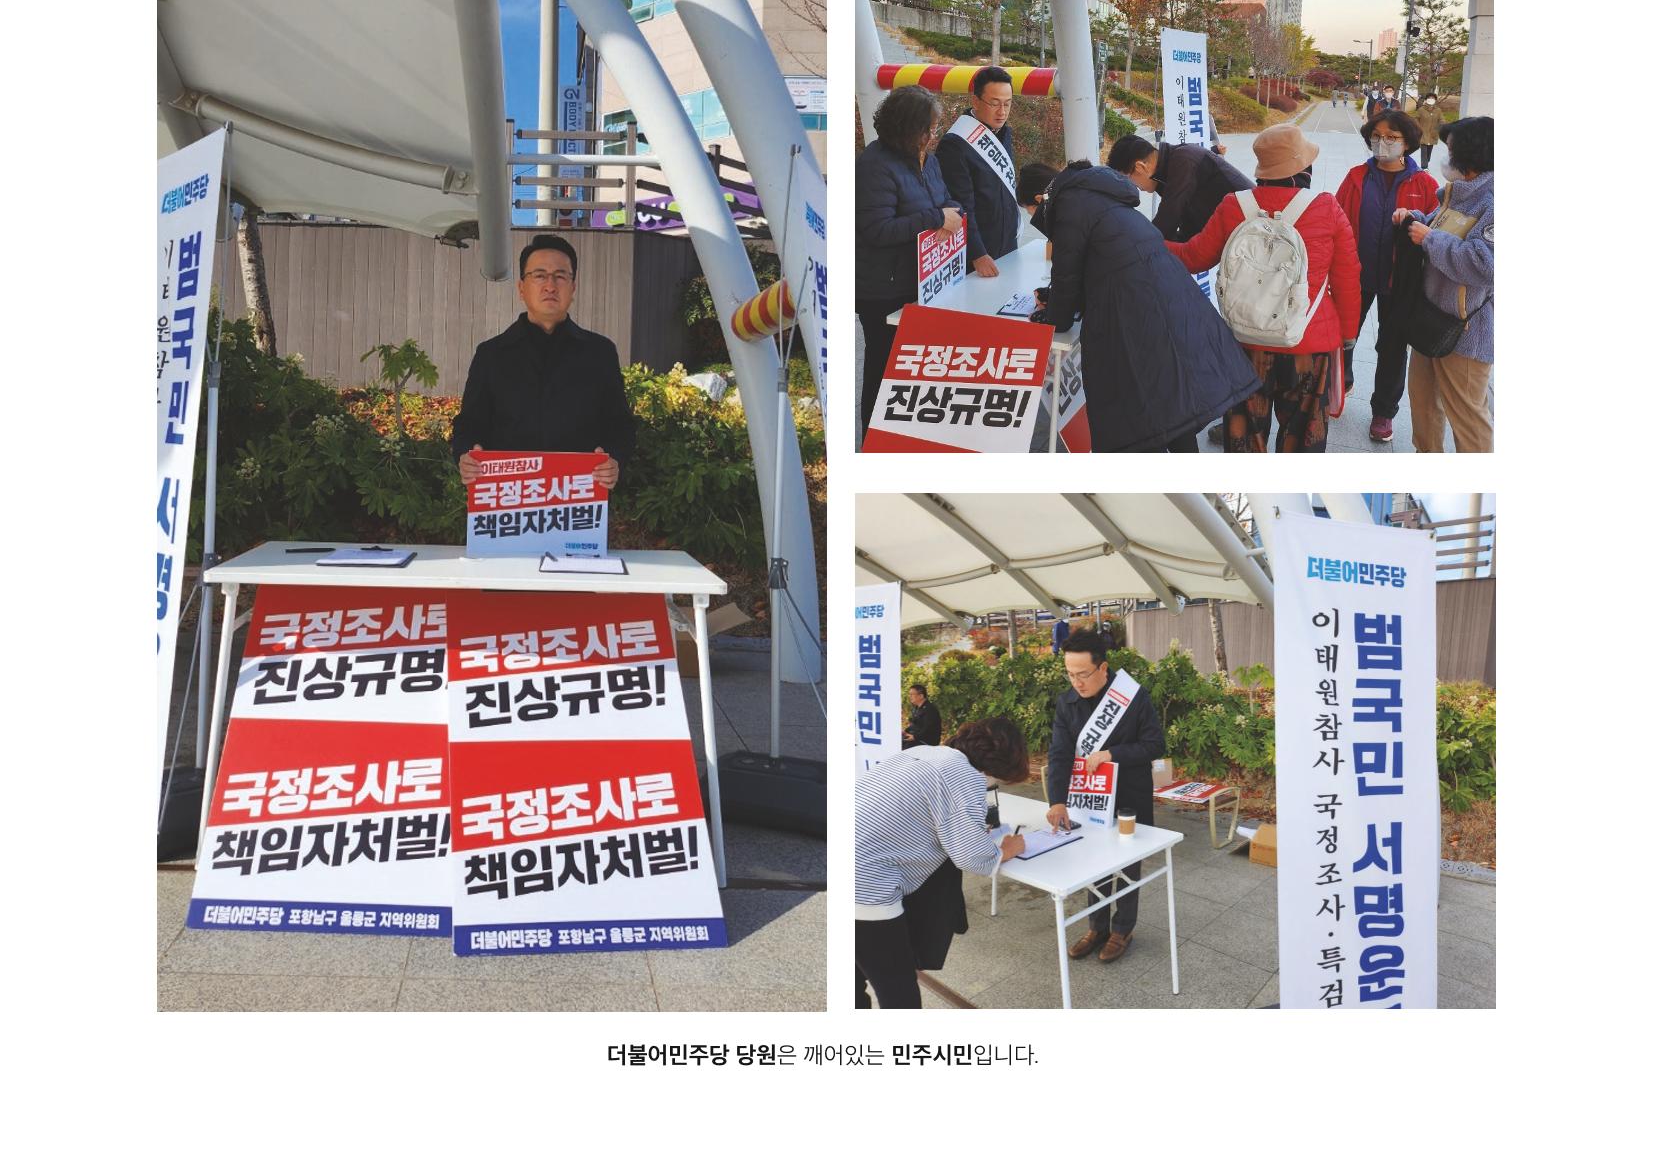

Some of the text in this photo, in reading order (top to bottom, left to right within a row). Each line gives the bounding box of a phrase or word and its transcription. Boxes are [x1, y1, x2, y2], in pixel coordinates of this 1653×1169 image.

[1188, 77, 1204, 147] 범국
[161, 173, 209, 215] 더불어민주당
[922, 251, 964, 305] 진상규명!
[165, 231, 202, 444] 범국민
[894, 344, 1039, 380] 국정조사로
[884, 385, 1032, 428] 진상규명!
[474, 474, 595, 508] 국정조사로
[481, 459, 539, 475] 이태원참사
[474, 504, 603, 539] 책임자처벌!
[1306, 556, 1407, 588] 더불어민주당
[460, 620, 660, 671] 국정조사로
[253, 648, 448, 705] 진상규명
[465, 664, 666, 728] 진상규명!
[858, 634, 882, 745] 범국민
[1311, 607, 1345, 777] 이태원참사
[222, 757, 444, 818] 국정조사로
[461, 772, 679, 840] 국정조사로
[1351, 612, 1406, 1009] 범국민 서명운
[212, 812, 451, 876] 책임자처벌!
[464, 825, 699, 900] 책임자처벌!
[203, 905, 440, 930] 더불어민주당 포항남구 울릉군 지역위원회
[470, 924, 710, 951] 더불어민주당 포항남구 울릉군 지역위원회
